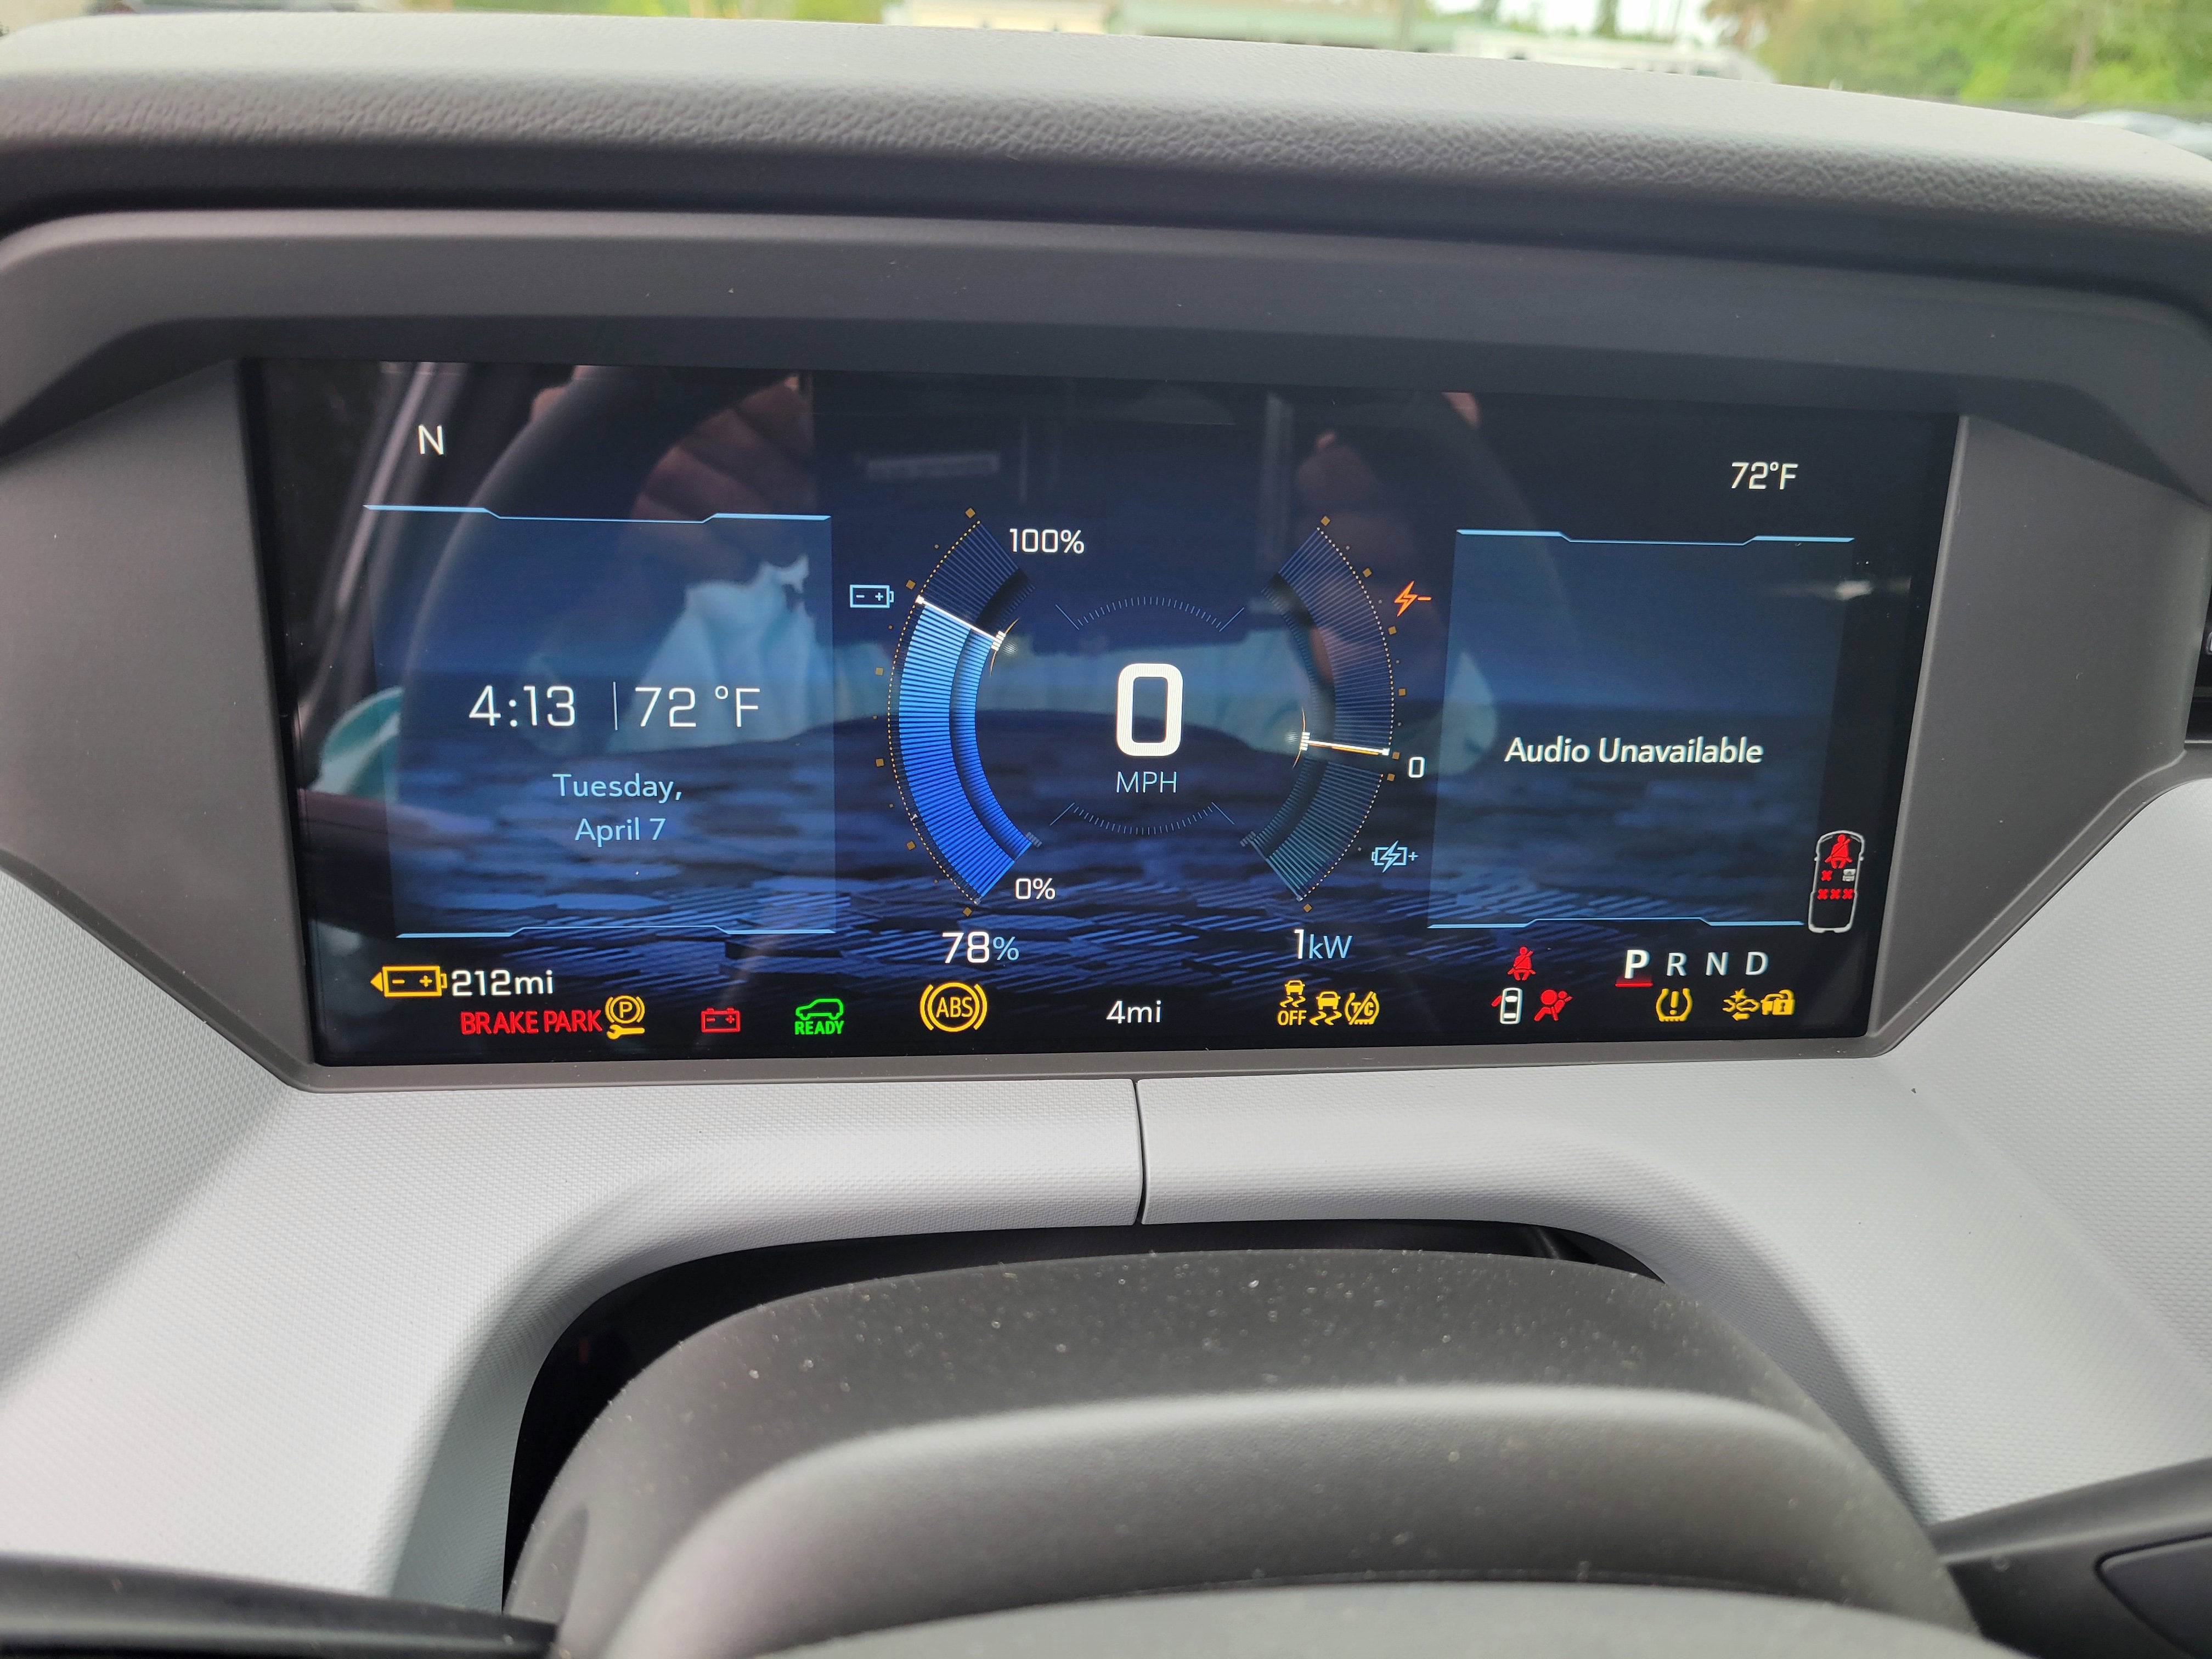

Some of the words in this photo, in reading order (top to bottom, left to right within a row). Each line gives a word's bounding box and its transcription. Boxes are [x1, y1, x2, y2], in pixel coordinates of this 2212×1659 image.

[419, 425, 443, 454] N
[1731, 462, 1798, 489] 72°F
[1010, 528, 1084, 554] 100%
[469, 686, 575, 726] 4:13
[1117, 663, 1183, 756] 0
[1504, 736, 1590, 762] Audio
[1599, 736, 1764, 764] Unavailable
[1409, 757, 1425, 777] 0
[552, 773, 682, 803] Tuesday,
[1117, 771, 1177, 793] MPH
[575, 817, 640, 847] April
[650, 819, 665, 840] 7
[1015, 878, 1056, 900] 0%
[942, 932, 1019, 963] 78%
[1624, 950, 1649, 979] P
[1667, 953, 1686, 976] R
[1706, 952, 1729, 976] N
[1746, 952, 1768, 975] D
[452, 970, 553, 996] 212mi
[935, 997, 973, 1018] ABS
[1107, 1001, 1161, 1024] 4mi
[1278, 1010, 1306, 1025] OFF
[461, 1011, 539, 1035] BRAKE
[544, 1009, 602, 1032] PARK
[794, 1021, 844, 1035] READY
